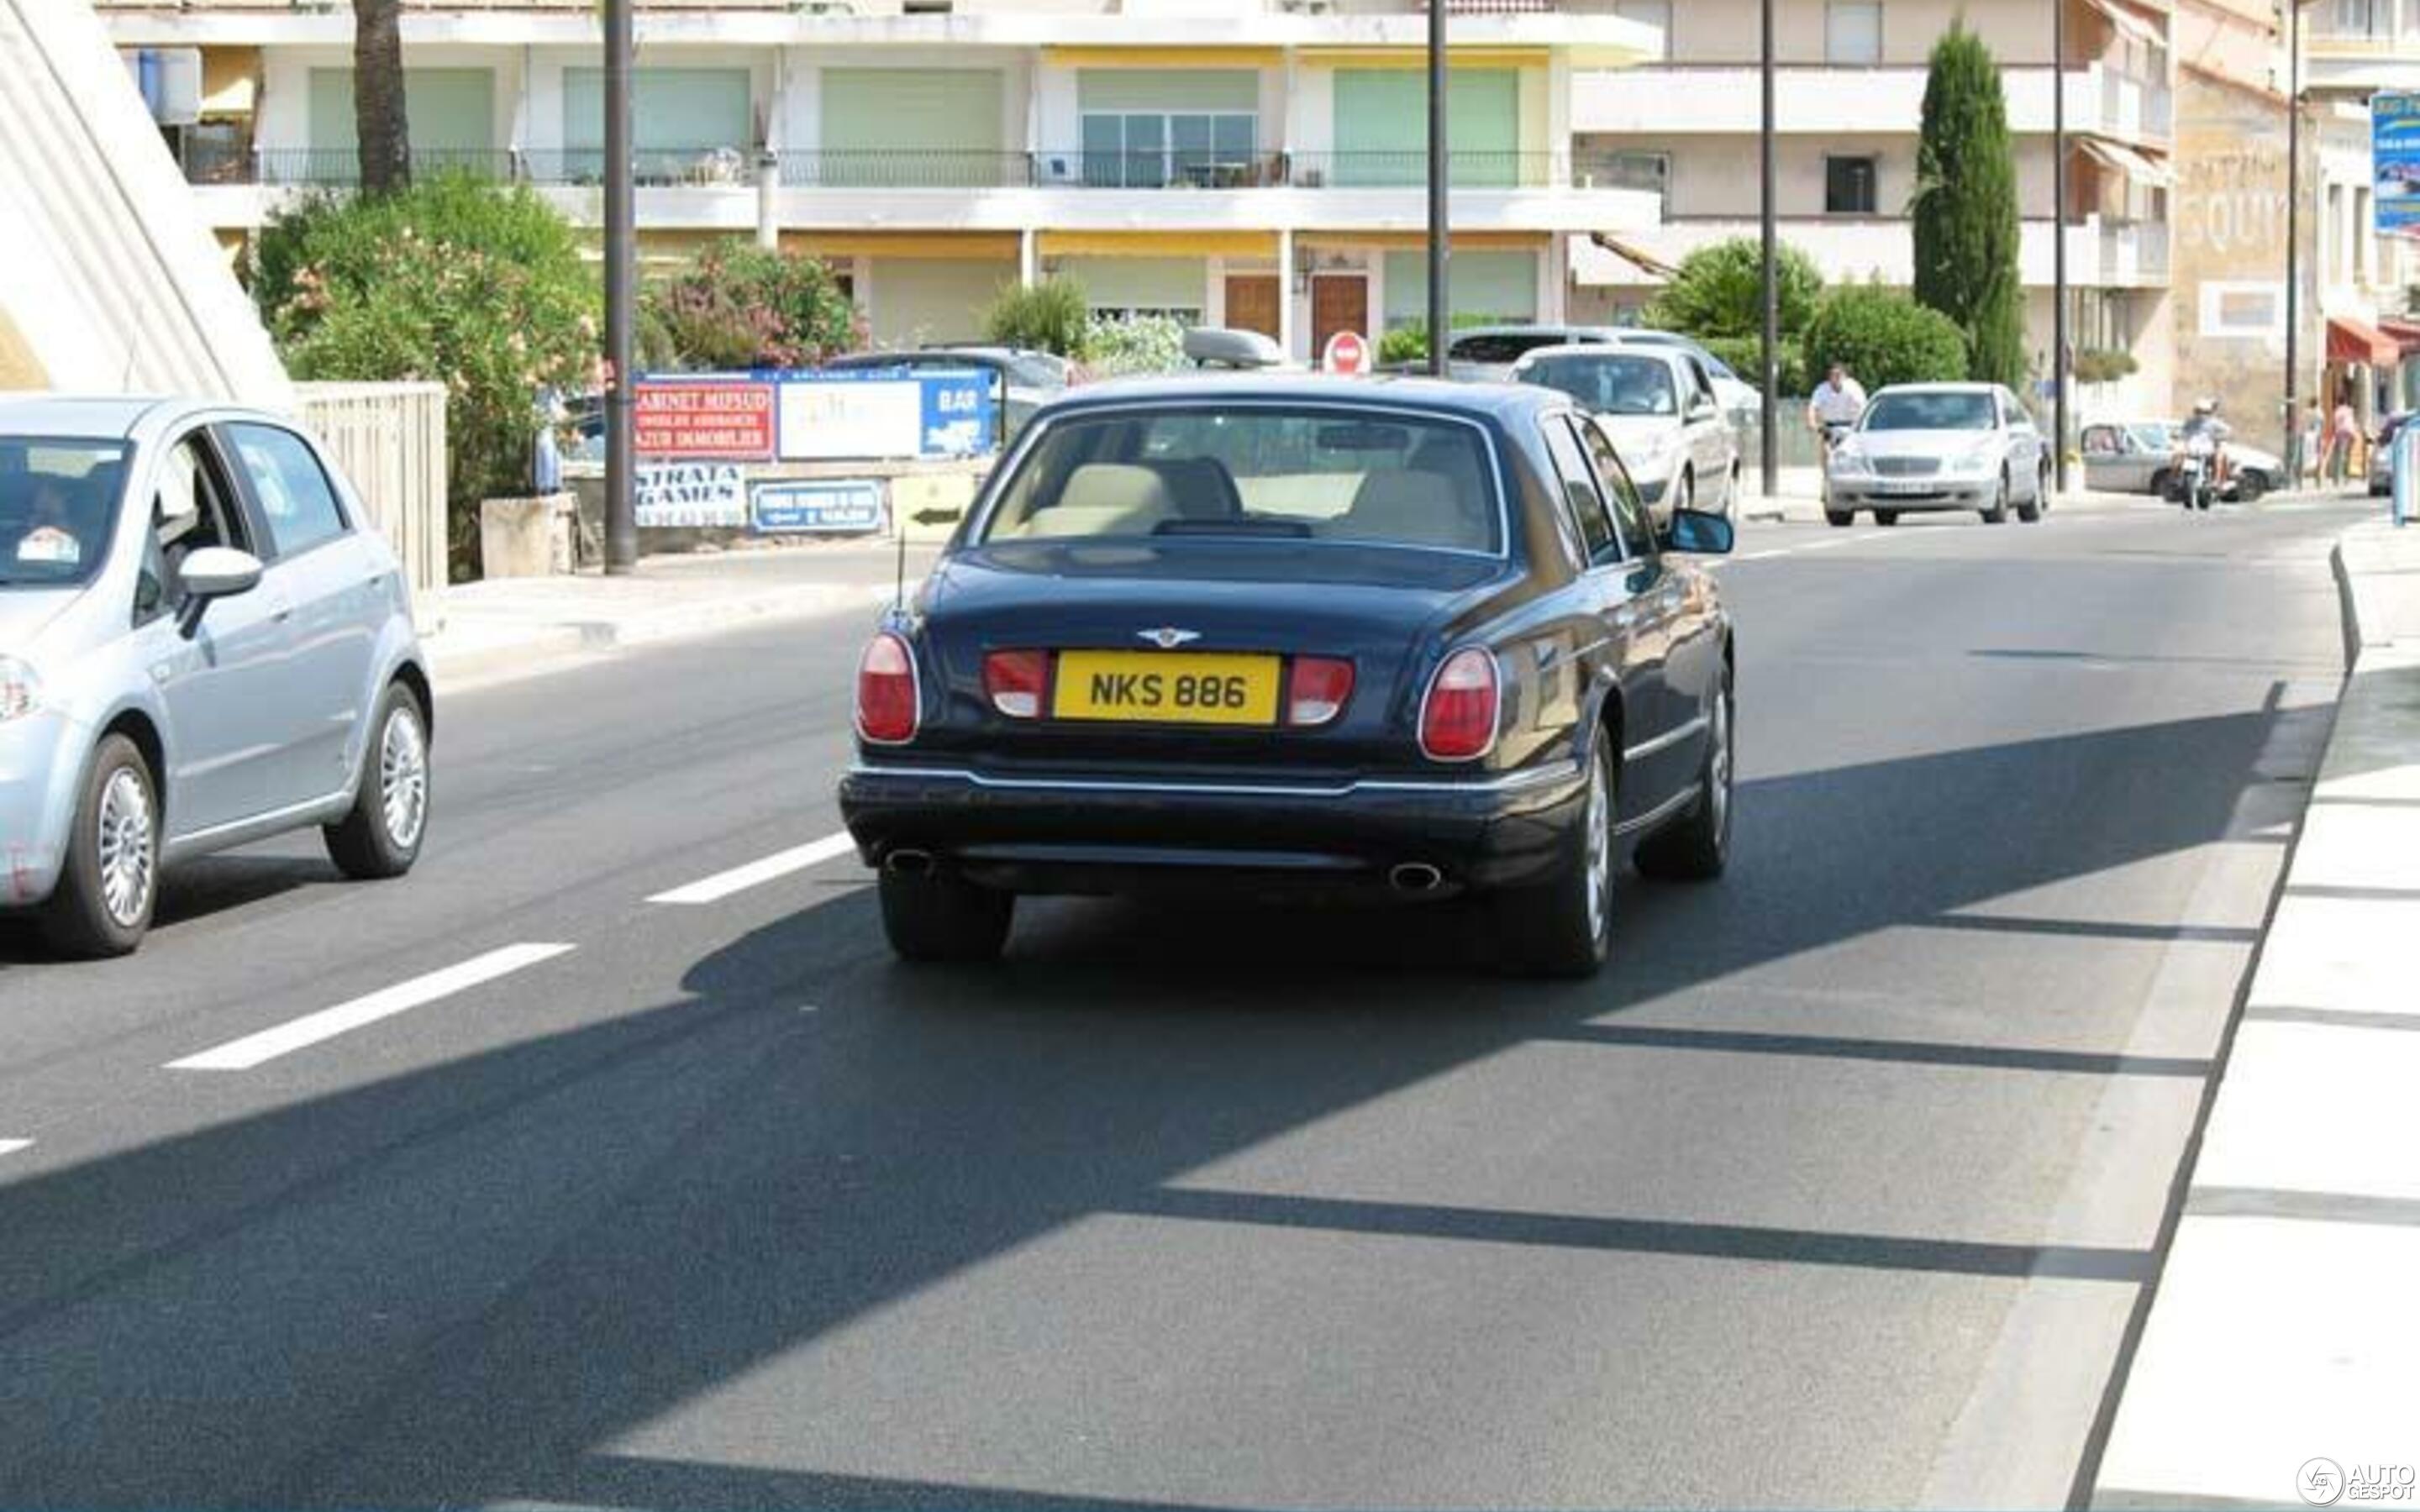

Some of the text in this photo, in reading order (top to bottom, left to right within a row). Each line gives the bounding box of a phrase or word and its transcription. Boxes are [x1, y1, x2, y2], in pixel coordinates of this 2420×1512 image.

[939, 390, 978, 412] BAR
[636, 466, 738, 487] STRATA
[636, 486, 734, 506] GAMES
[1091, 674, 1246, 707] NKS 886
